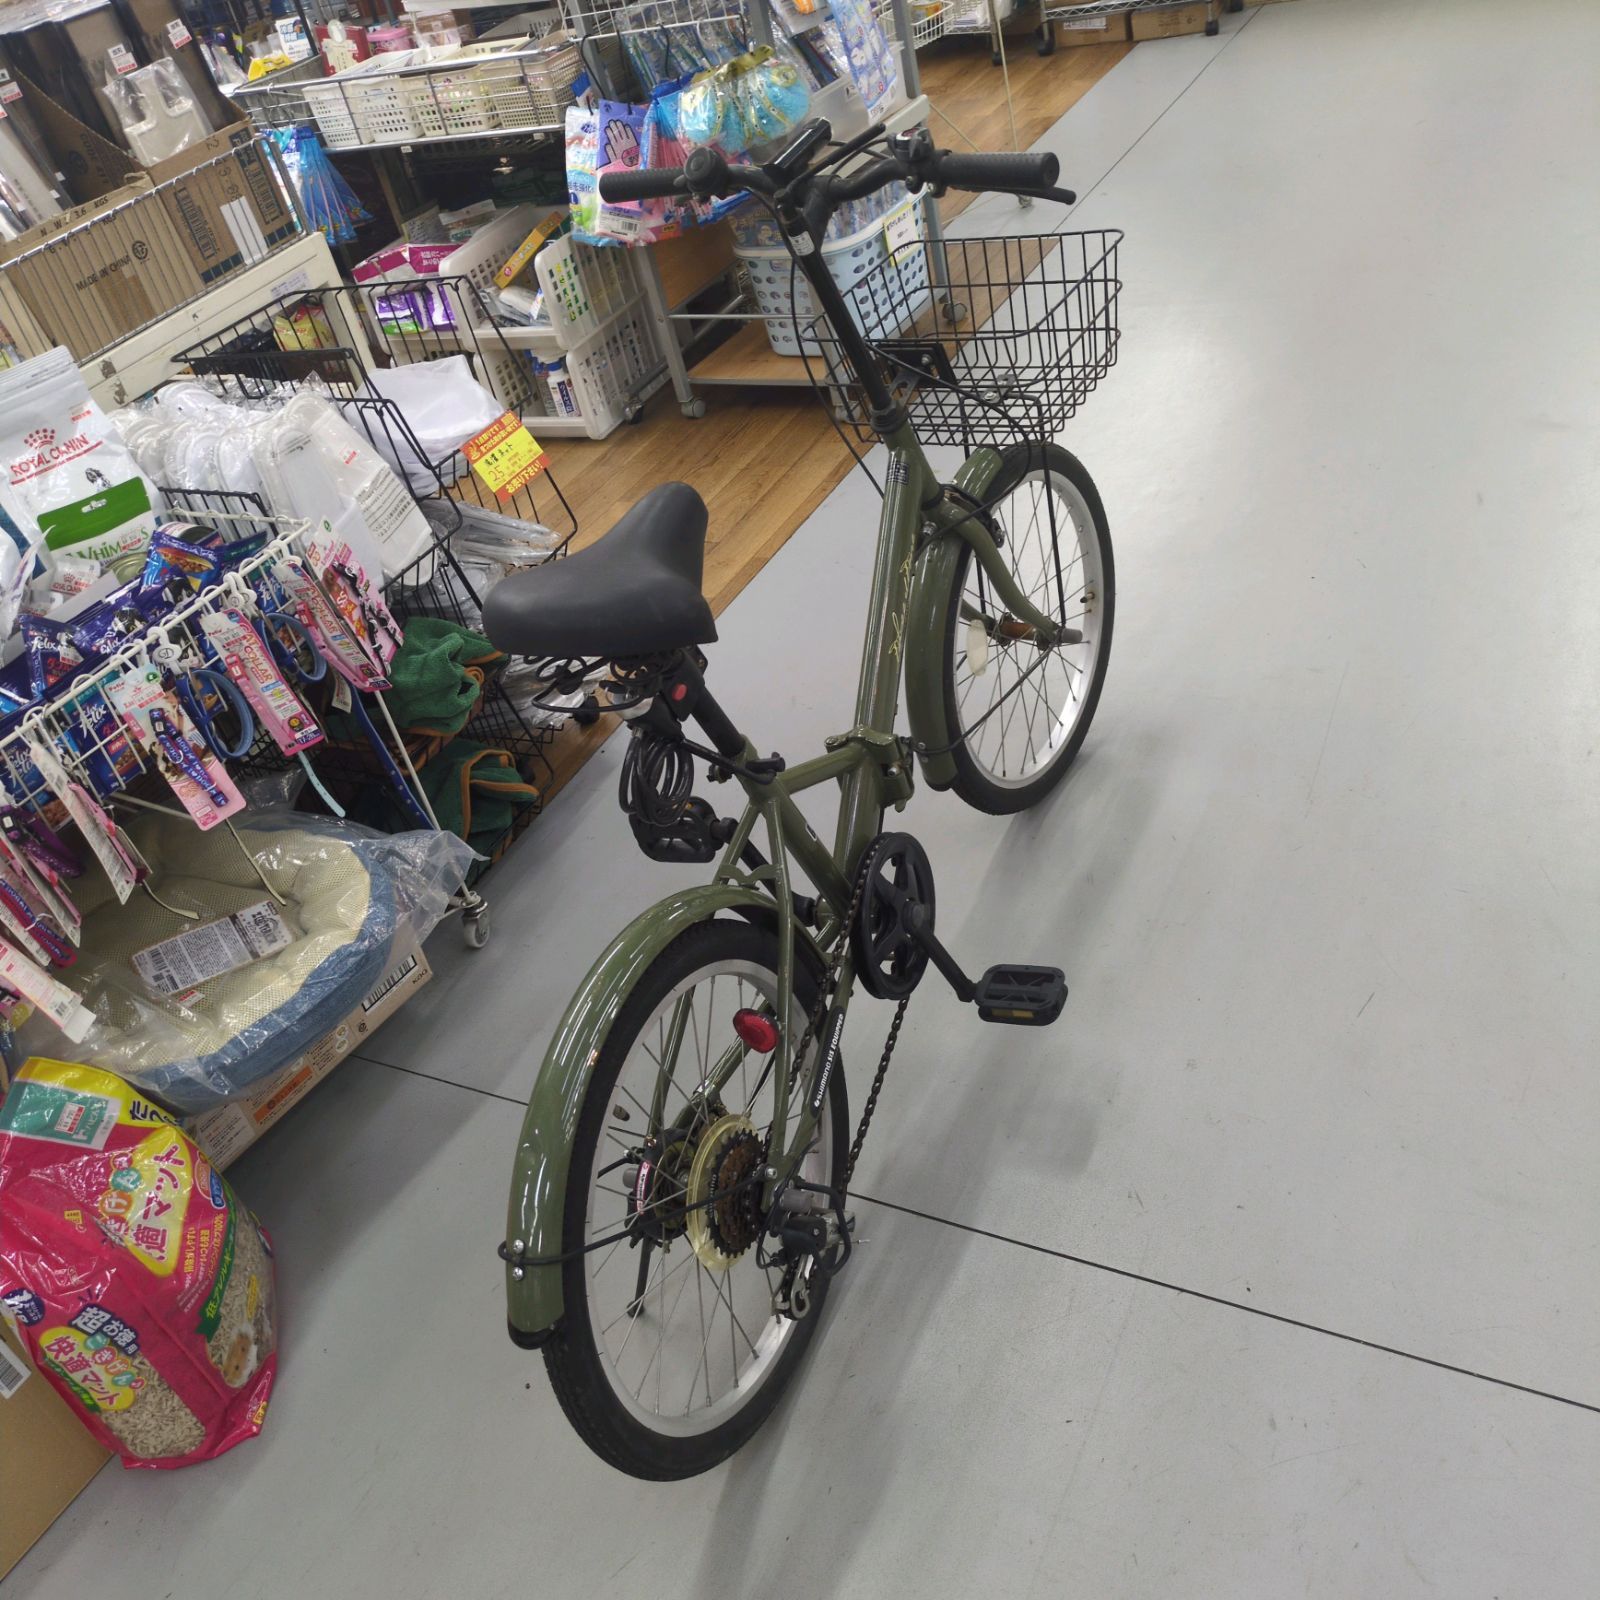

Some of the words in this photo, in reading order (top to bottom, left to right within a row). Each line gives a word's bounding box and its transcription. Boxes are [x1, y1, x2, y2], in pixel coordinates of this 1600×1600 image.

[75, 273, 98, 291] MADE
[109, 254, 132, 272] CHINA
[10, 450, 51, 477] ROYAL
[49, 433, 91, 460] CANIN
[31, 636, 57, 652] felix
[243, 645, 273, 683] COLLAR
[817, 1062, 832, 1100] SHIMANO
[827, 1050, 835, 1062] SIS
[831, 1013, 844, 1051] EQUIPPED
[44, 1335, 121, 1406] 快適マット
